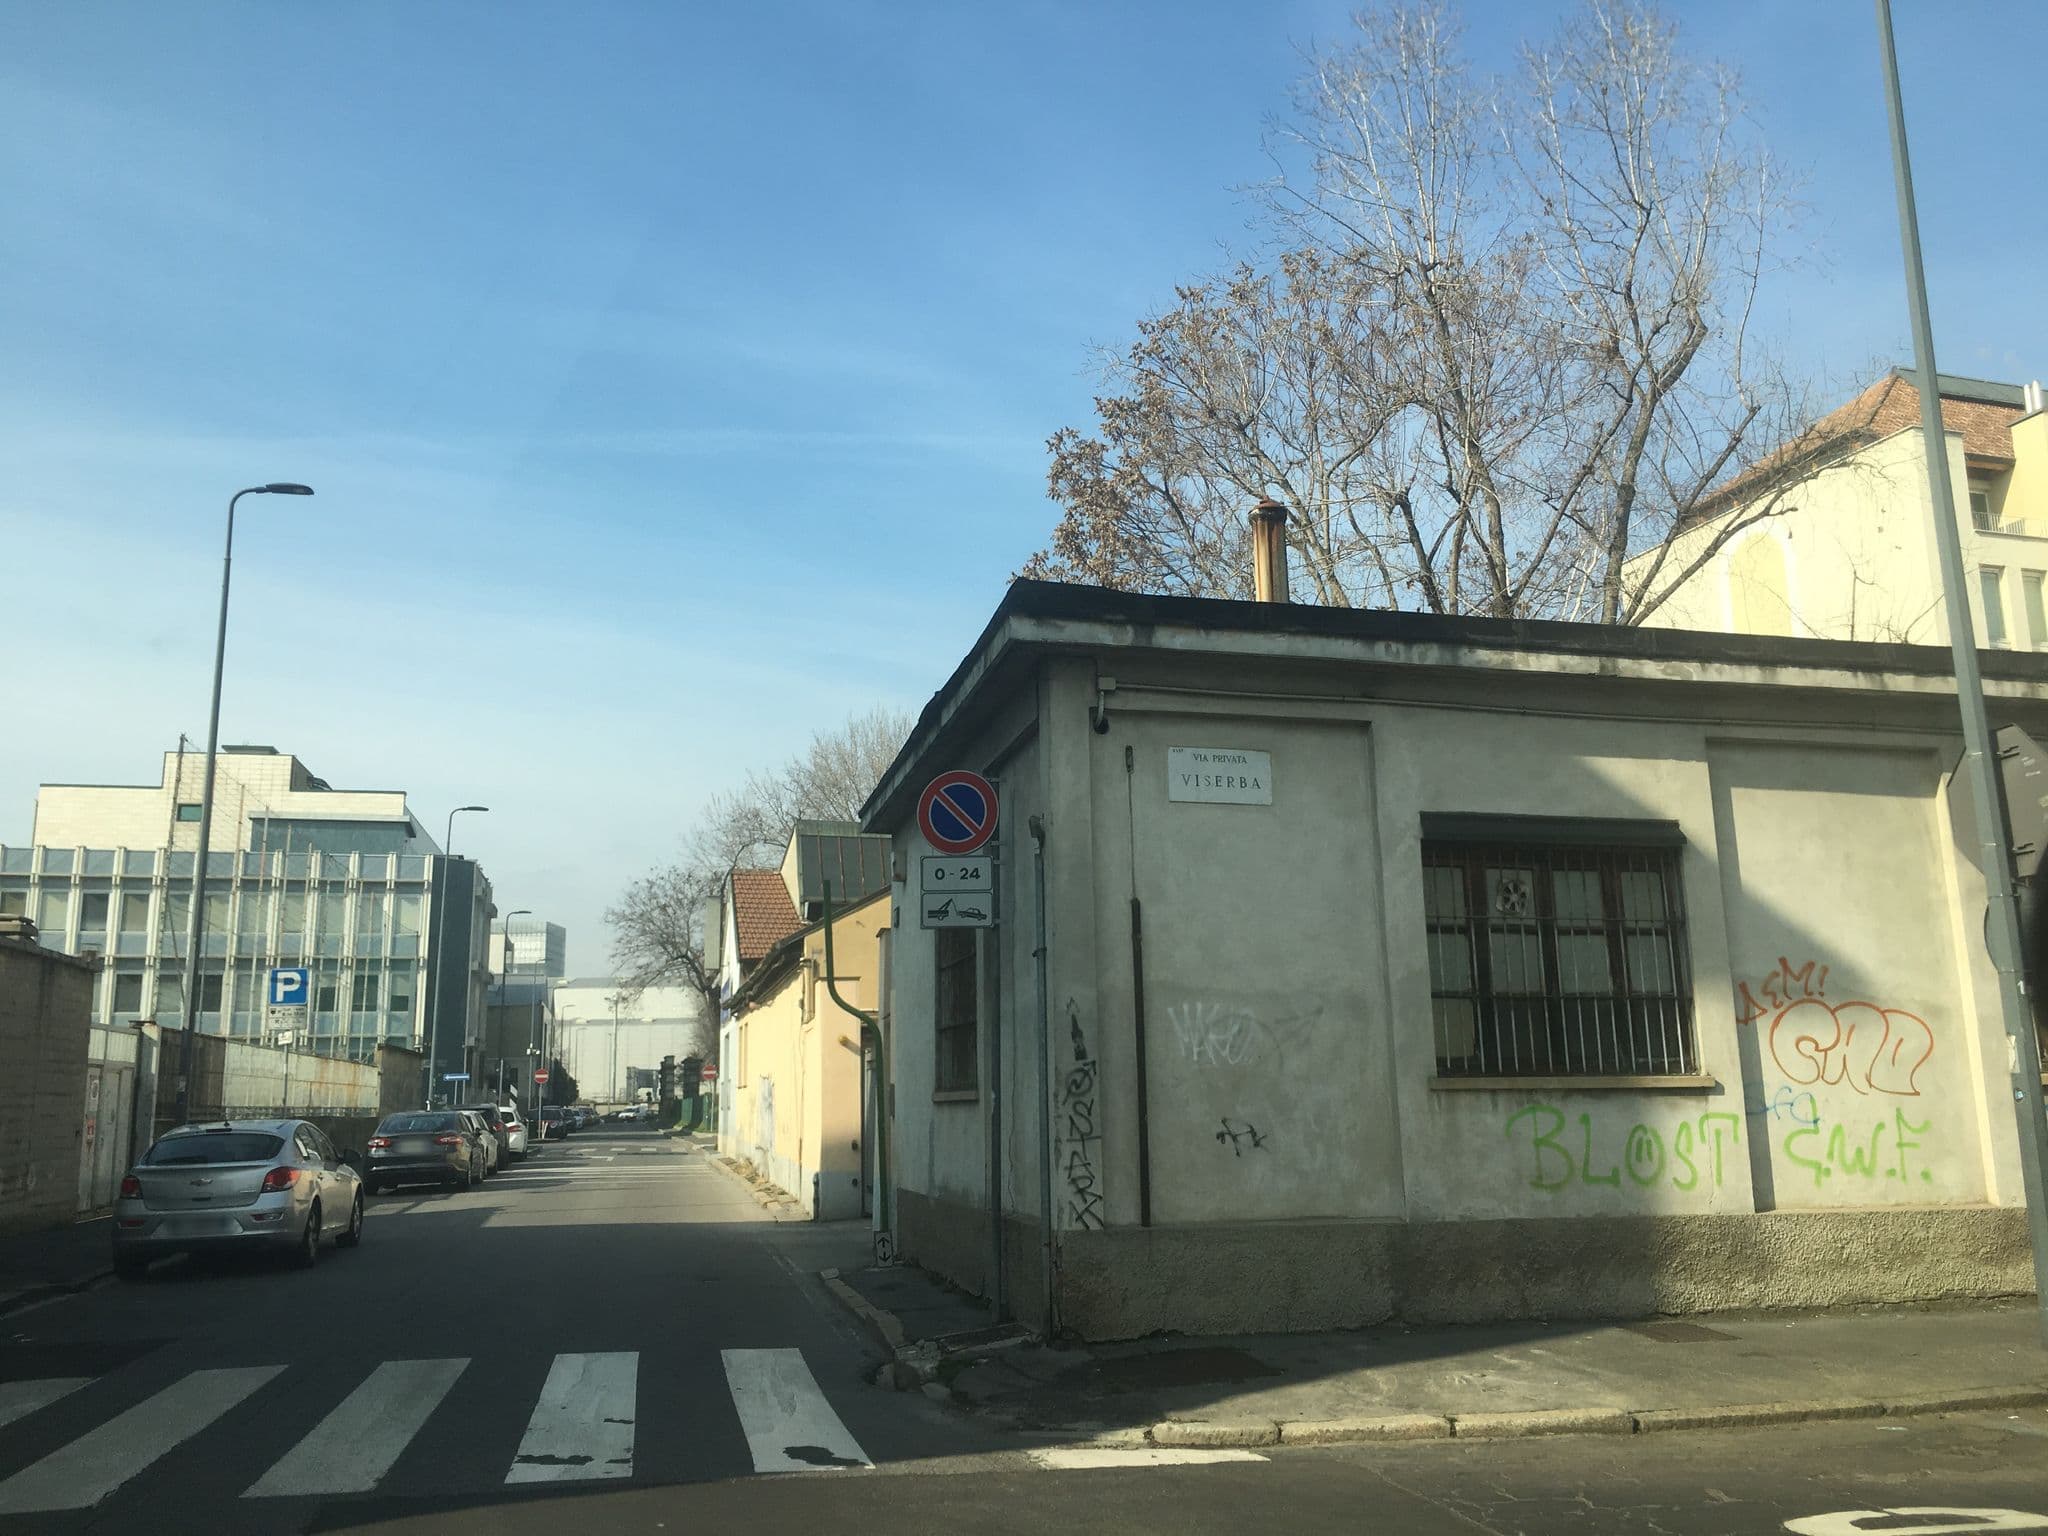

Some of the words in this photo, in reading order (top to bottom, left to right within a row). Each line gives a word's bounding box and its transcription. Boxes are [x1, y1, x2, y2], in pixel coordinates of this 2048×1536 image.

[1193, 753, 1209, 762] VIA
[1212, 755, 1248, 764] PRIVATA
[1181, 774, 1262, 789] VISERBA
[935, 868, 946, 880] 0
[960, 867, 981, 880] 24
[275, 971, 302, 1002] P
